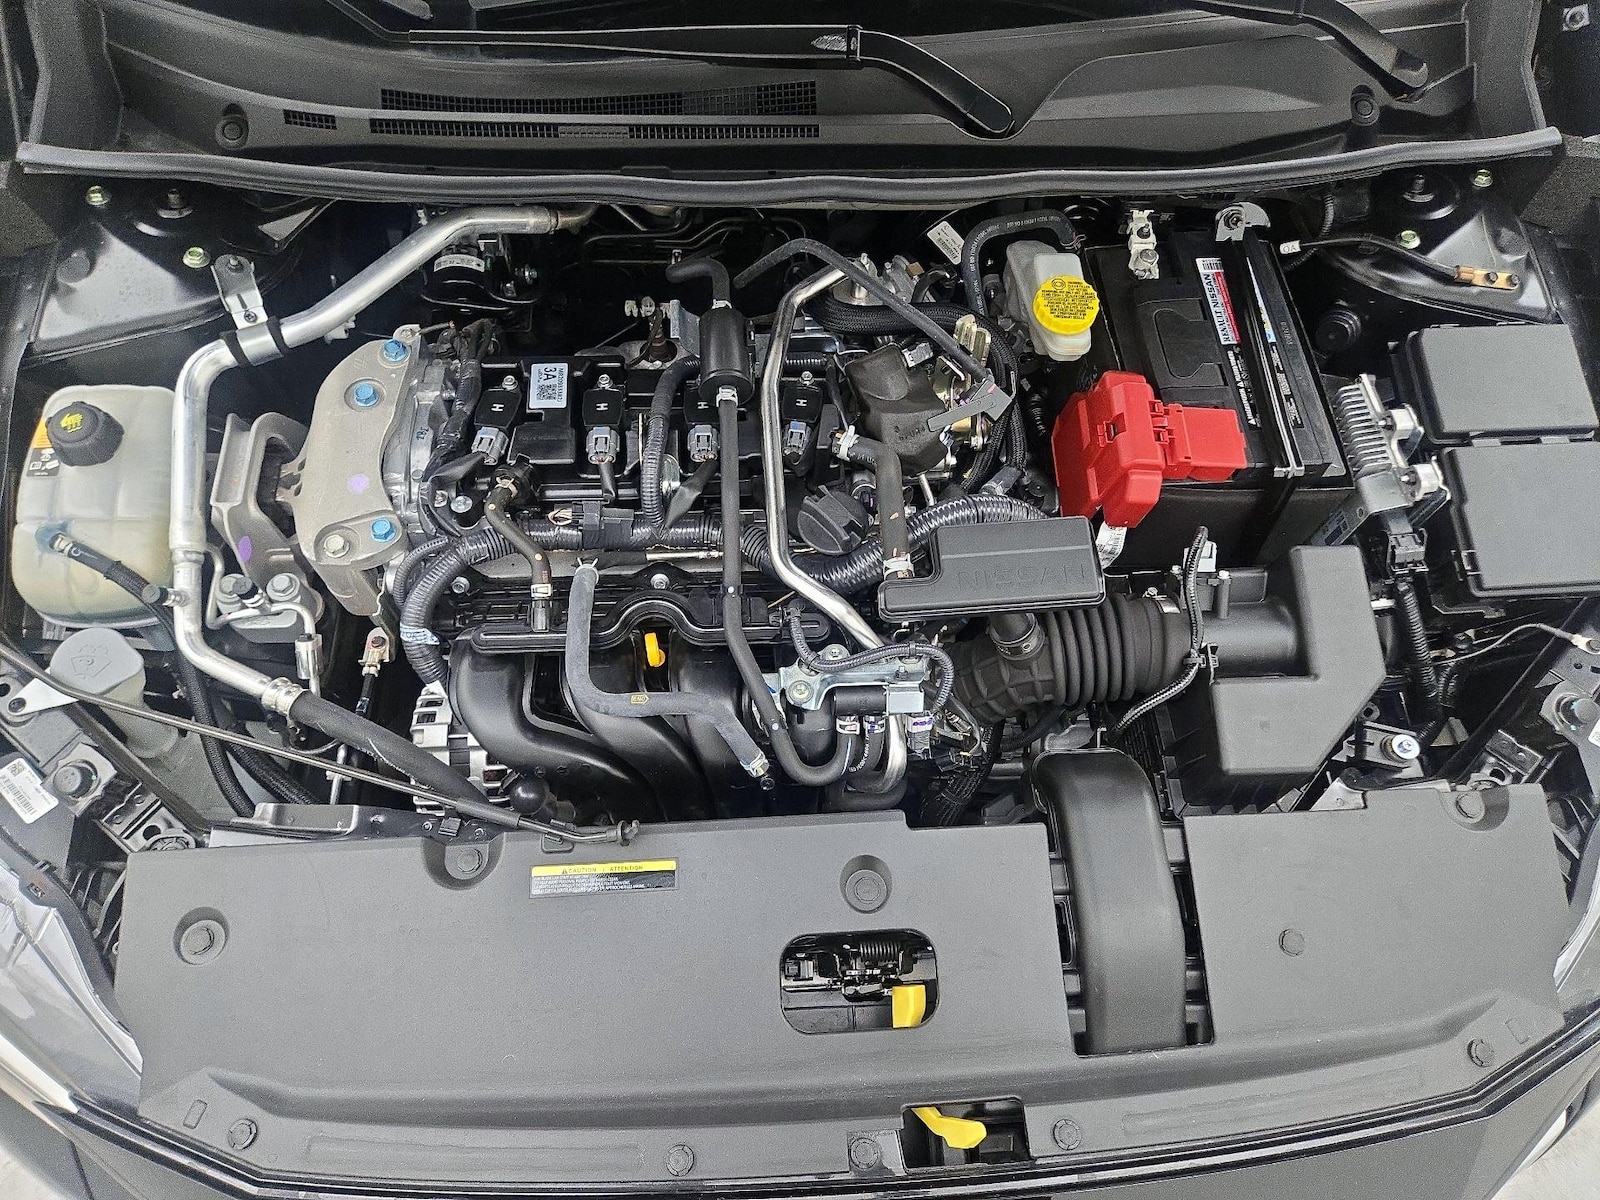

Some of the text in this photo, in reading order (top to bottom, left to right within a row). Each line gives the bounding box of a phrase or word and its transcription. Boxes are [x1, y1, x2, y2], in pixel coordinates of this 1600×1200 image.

[1203, 273, 1219, 308] NISSAN
[1213, 309, 1231, 343] RENAULT
[544, 367, 557, 381] 3A
[596, 403, 608, 411] H
[957, 563, 1093, 592] NISSAN
